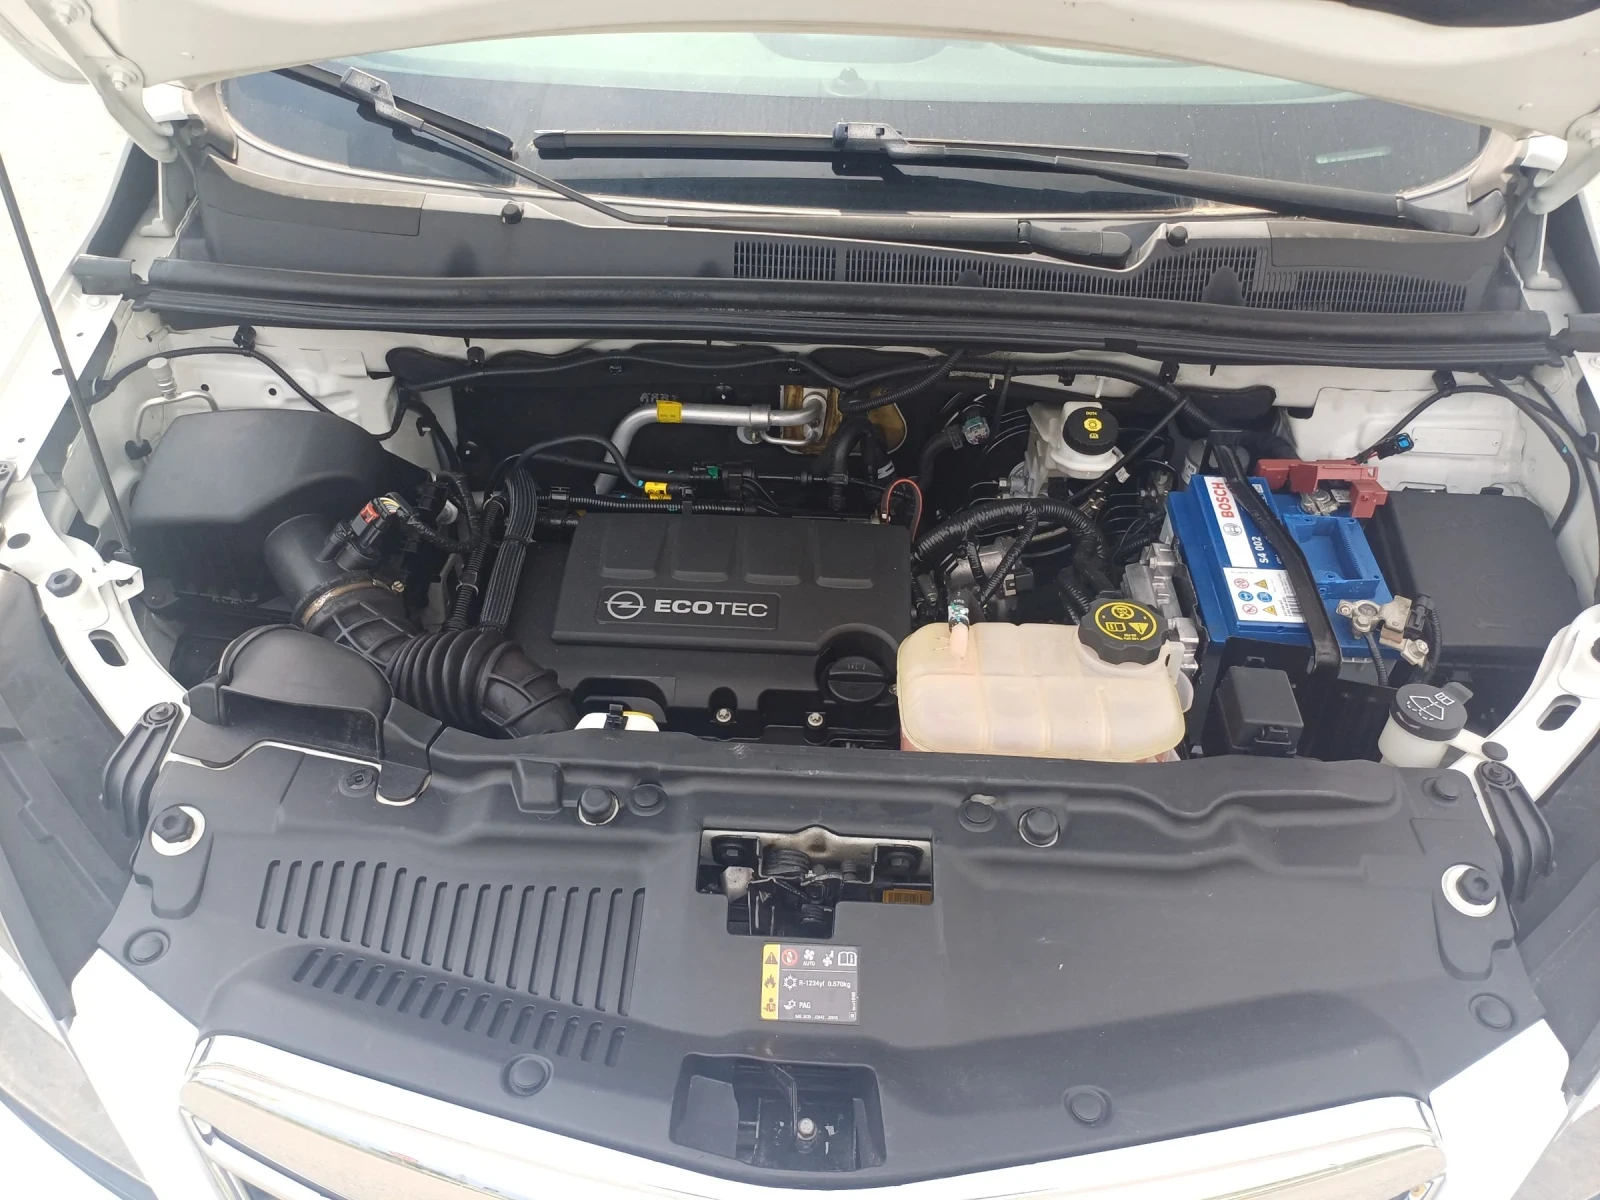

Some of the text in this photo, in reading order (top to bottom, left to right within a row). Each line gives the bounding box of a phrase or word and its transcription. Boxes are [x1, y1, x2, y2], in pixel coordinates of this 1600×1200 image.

[1211, 482, 1235, 518] BOSCH
[1251, 536, 1269, 564] S4 002
[654, 599, 768, 617] ECOTEC
